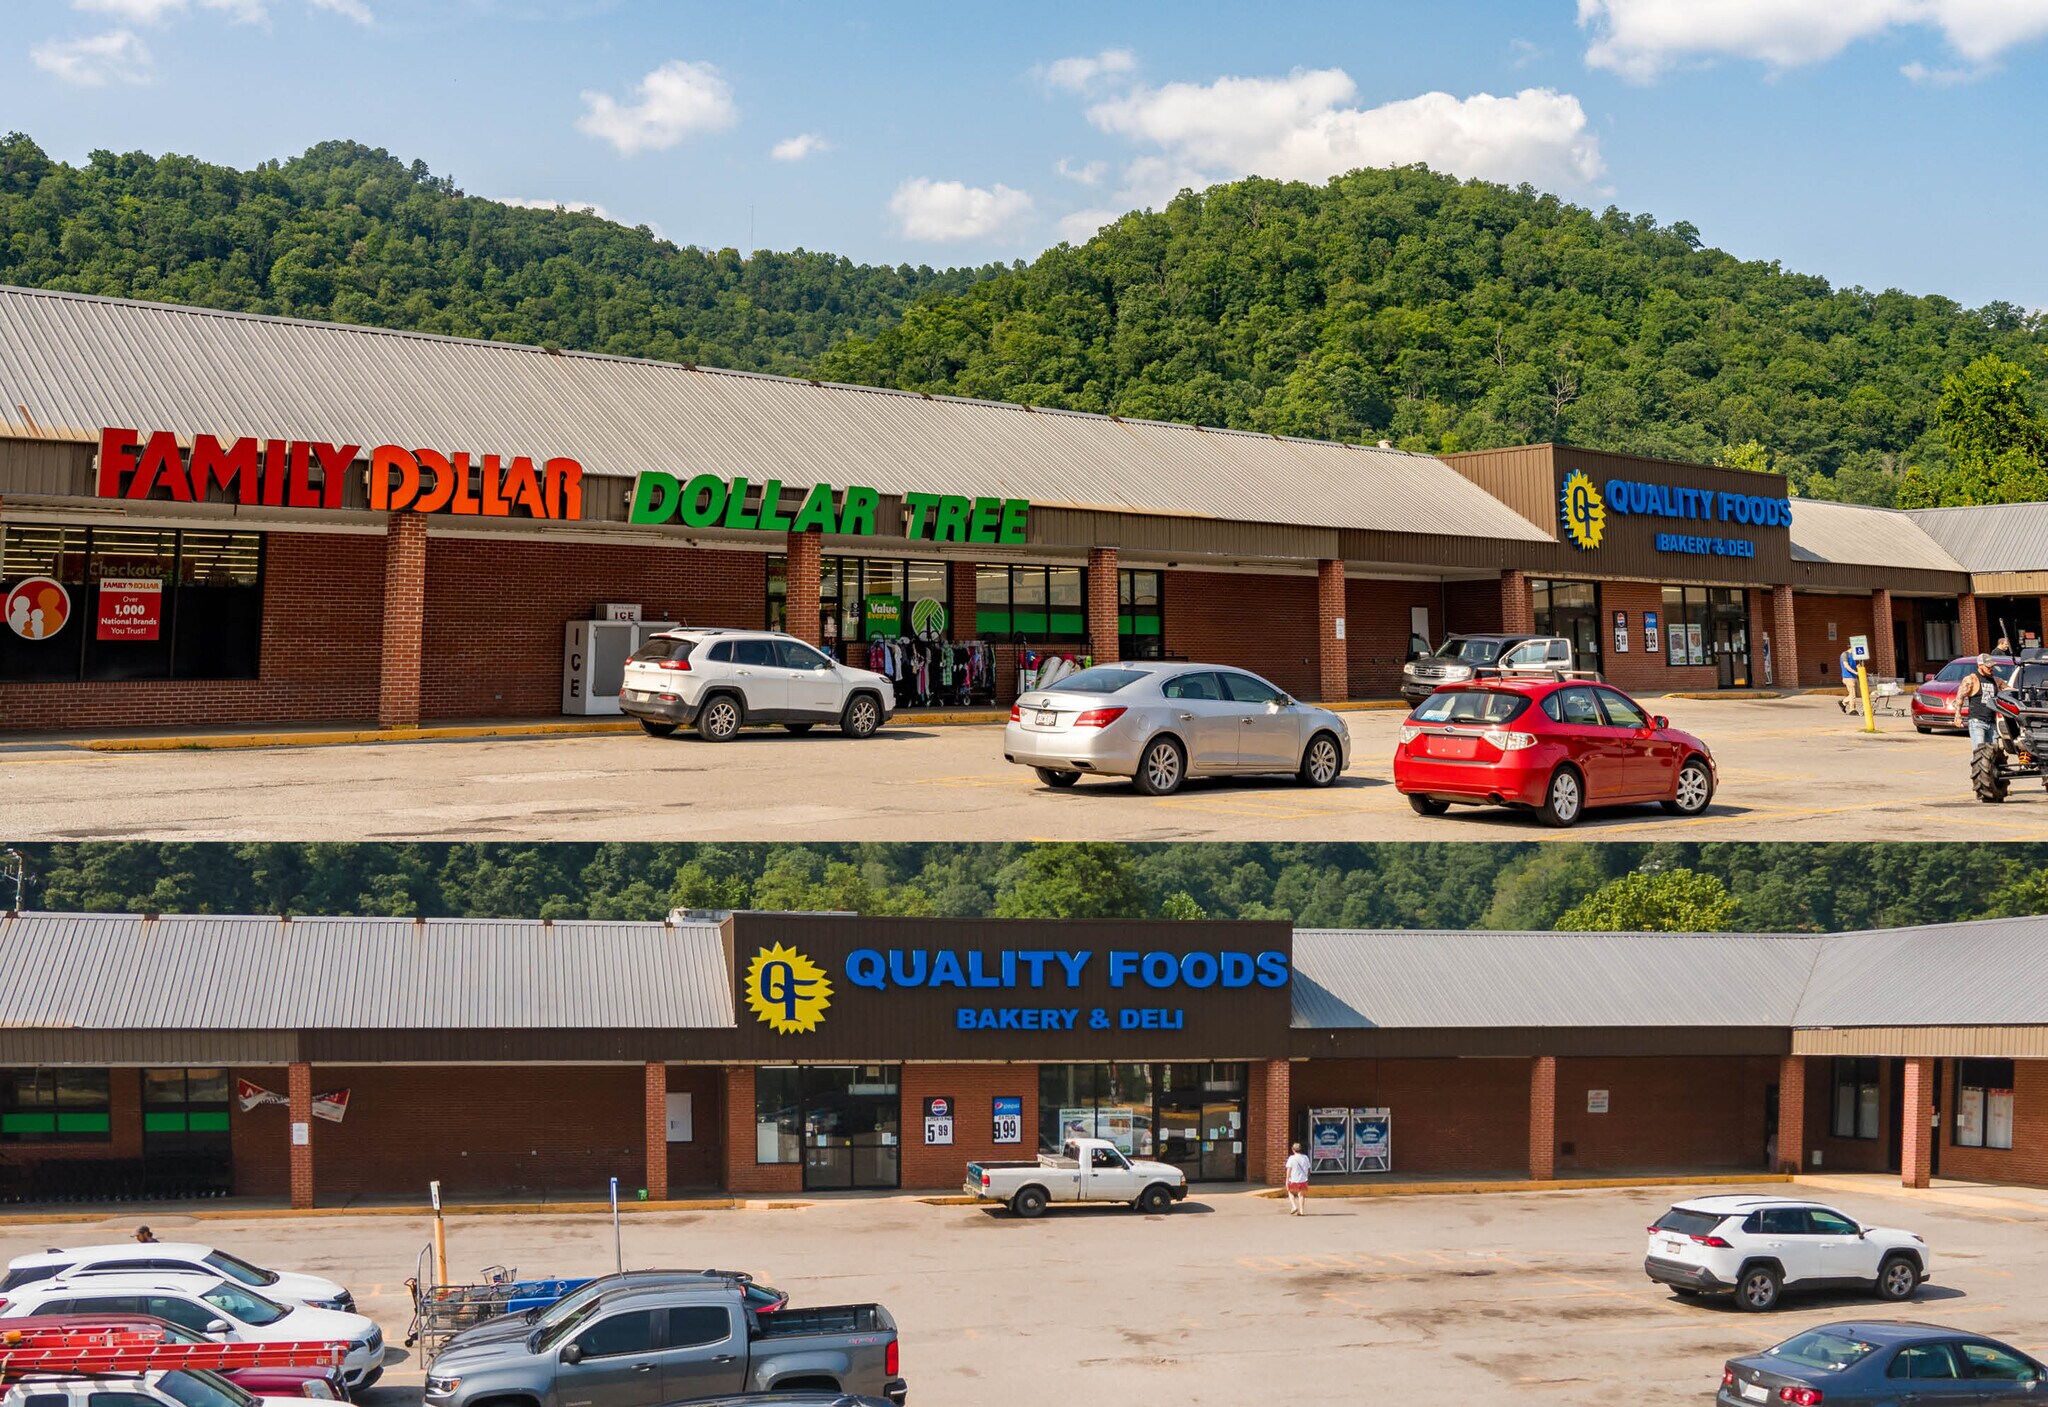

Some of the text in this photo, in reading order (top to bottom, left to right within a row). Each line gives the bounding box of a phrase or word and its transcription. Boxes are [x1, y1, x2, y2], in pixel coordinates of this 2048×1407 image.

[97, 427, 583, 520] FAMILY DOLLAR
[629, 471, 1031, 545] DOLLAR TREE
[1605, 479, 1793, 528] QUALITY FOODS
[1655, 533, 1755, 559] BAKERY & DELI
[90, 560, 164, 577] Checkout
[103, 581, 127, 589] FAMILY
[114, 604, 145, 616] 1,000
[615, 611, 635, 620] ICE
[868, 612, 898, 621] Everyday
[871, 603, 898, 613] Value
[101, 617, 157, 625] National Brands
[111, 627, 147, 635] You Trust!
[570, 628, 581, 698] ICE
[846, 948, 1288, 991] QUALITY FOODS
[957, 1008, 1184, 1030] BAKERY & DELI
[927, 1123, 949, 1142] 5 99
